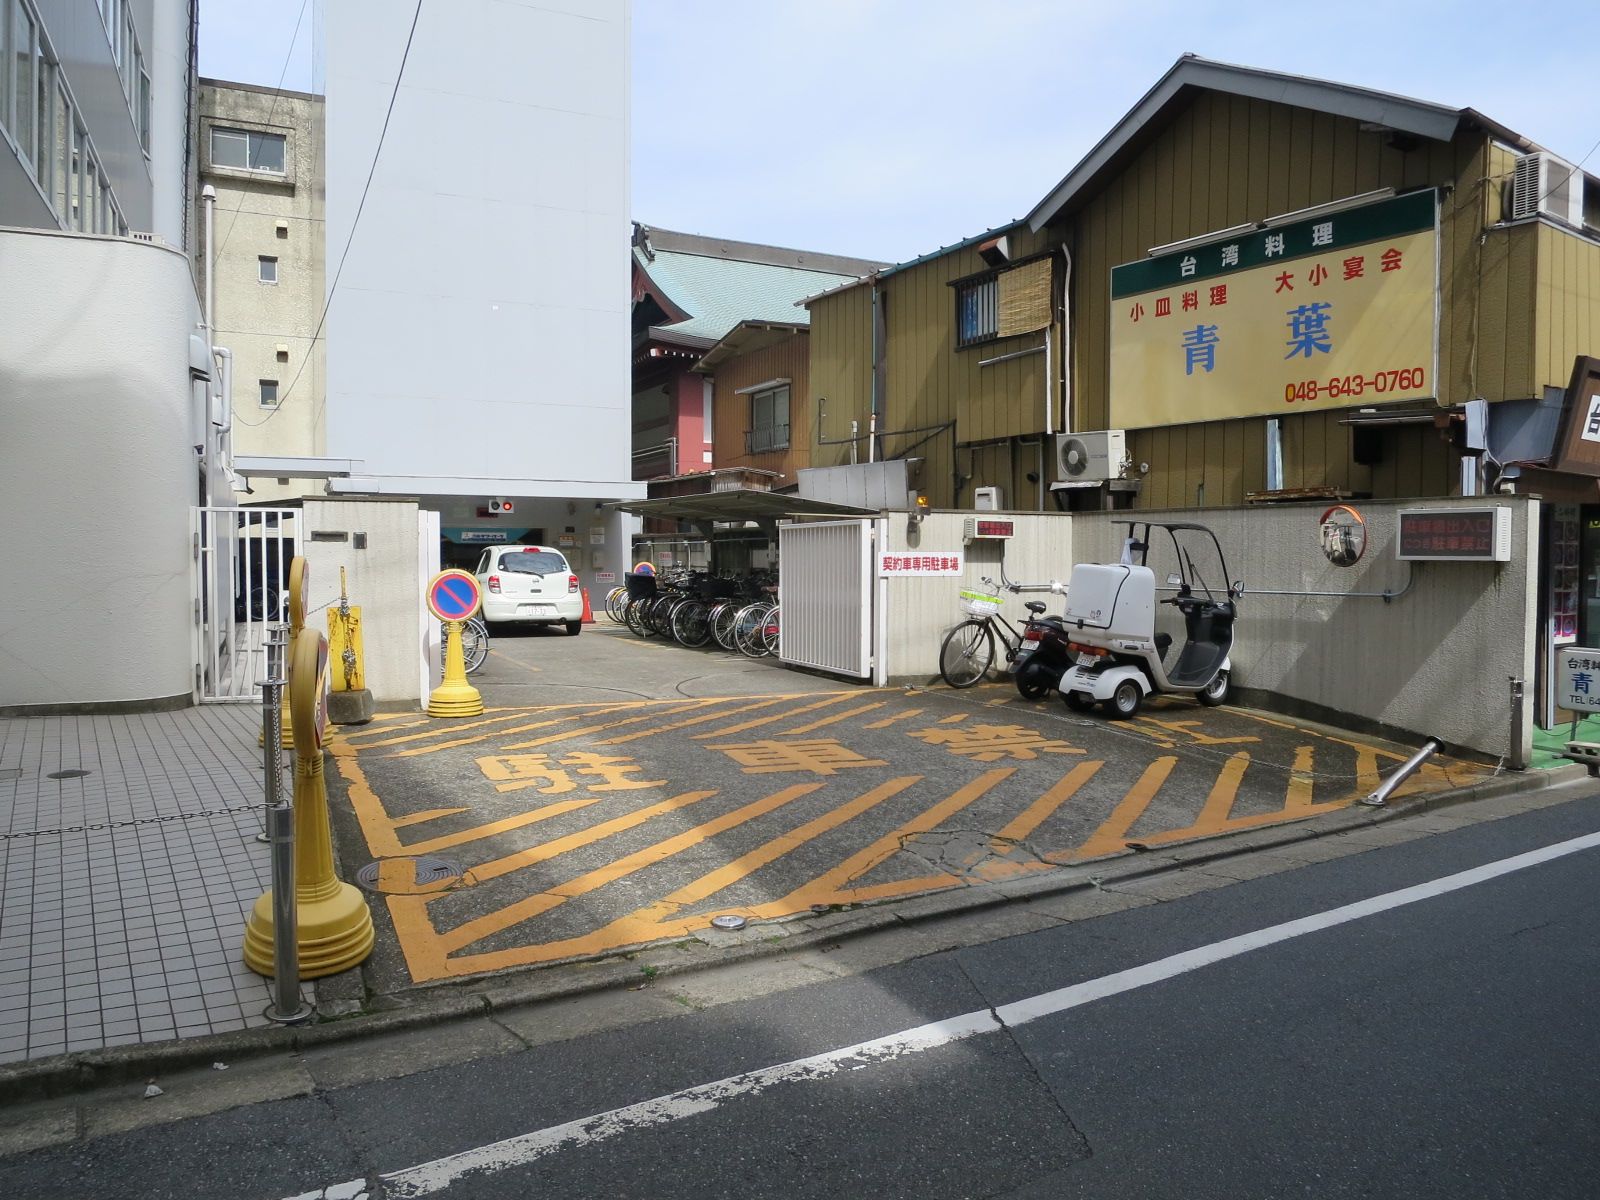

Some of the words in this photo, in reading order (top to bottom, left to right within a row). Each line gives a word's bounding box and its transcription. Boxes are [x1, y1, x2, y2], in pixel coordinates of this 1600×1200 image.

[1180, 221, 1334, 277] 台湾料理
[1275, 248, 1403, 294] 大小宴会
[1130, 284, 1228, 323] 小皿料理
[1181, 302, 1333, 376] 青葉
[1285, 367, 1425, 403] 048-643-0760
[882, 557, 959, 571] 契約車専用駐車場
[1569, 694, 1586, 705] TEL
